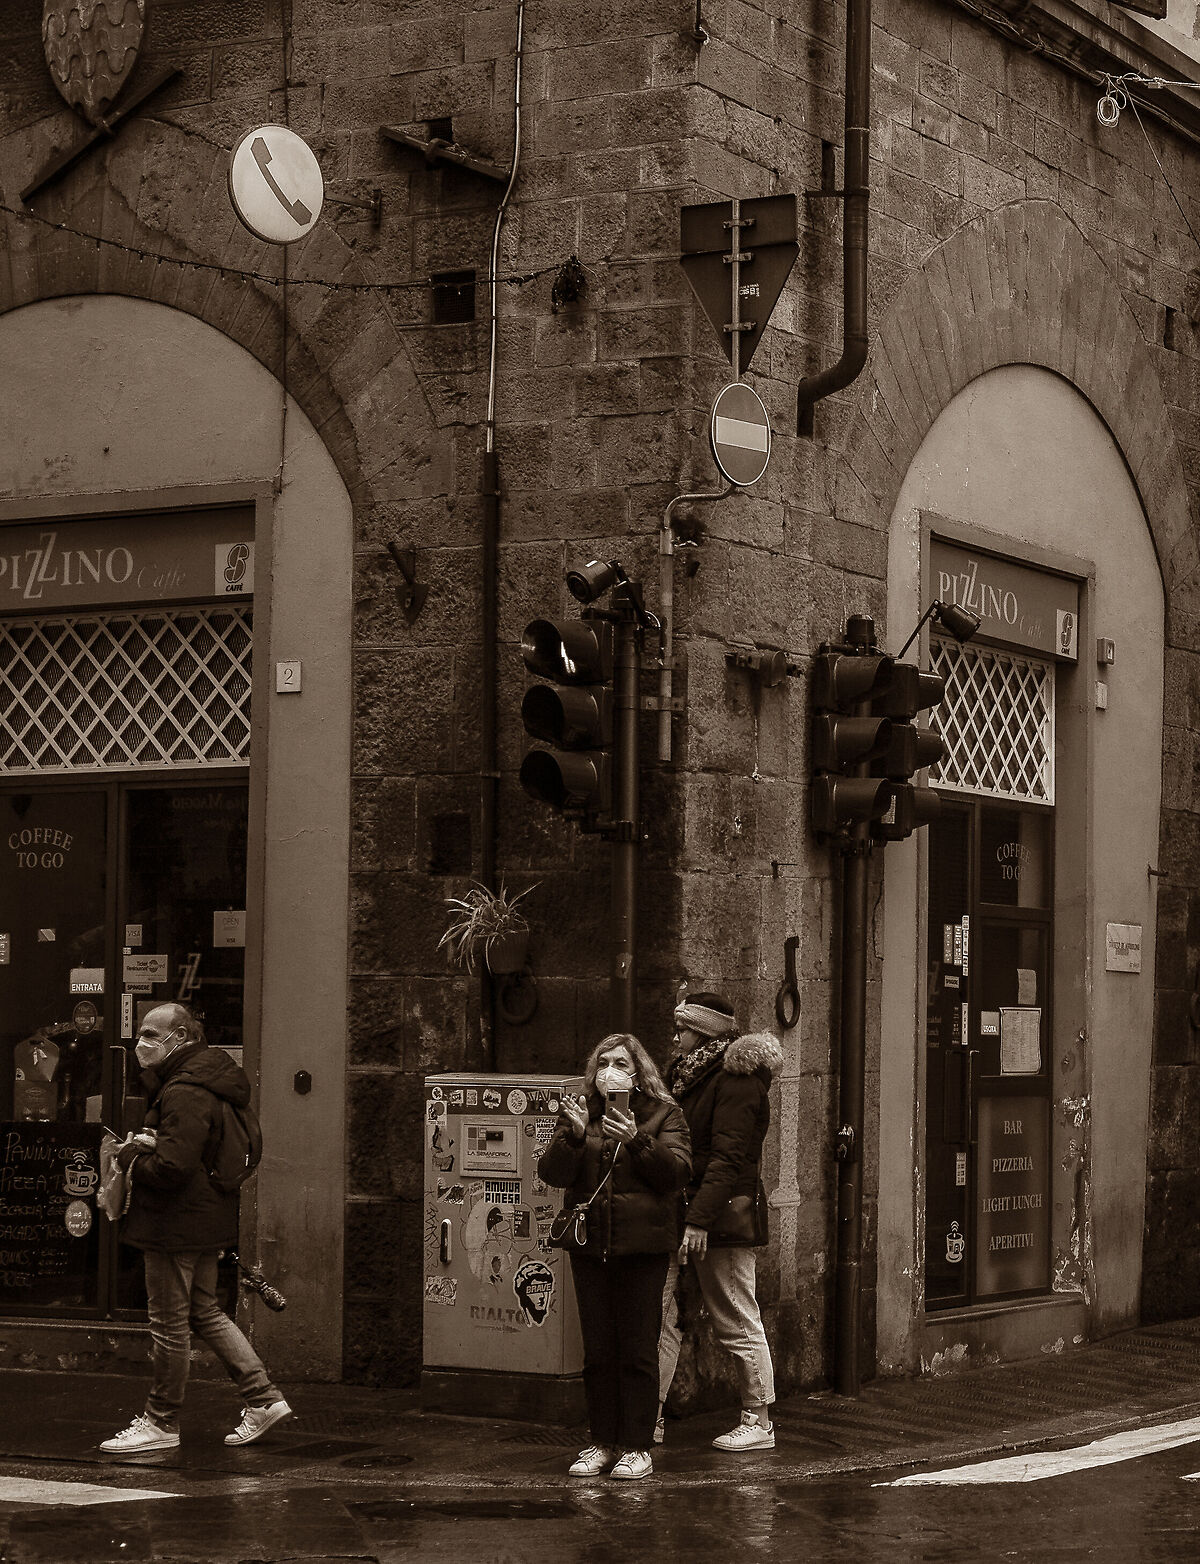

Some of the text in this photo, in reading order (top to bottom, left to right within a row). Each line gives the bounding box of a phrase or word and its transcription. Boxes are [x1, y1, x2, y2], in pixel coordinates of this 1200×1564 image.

[939, 560, 1018, 625] PIZZINO
[284, 668, 294, 685] 2
[8, 827, 74, 851] COFFEE
[16, 852, 64, 869] TO GO
[996, 842, 1033, 864] COFFEE
[1001, 864, 1013, 880] TO
[71, 983, 103, 992] ENTRATA
[1003, 1120, 1024, 1135] BAR
[992, 1156, 1034, 1173] PIZZERIA
[982, 1194, 1043, 1213] LIGHT LUNCH
[989, 1233, 1034, 1251] APERITIVI
[526, 1283, 552, 1295] BRAVE
[470, 1305, 526, 1326] RIALTO
